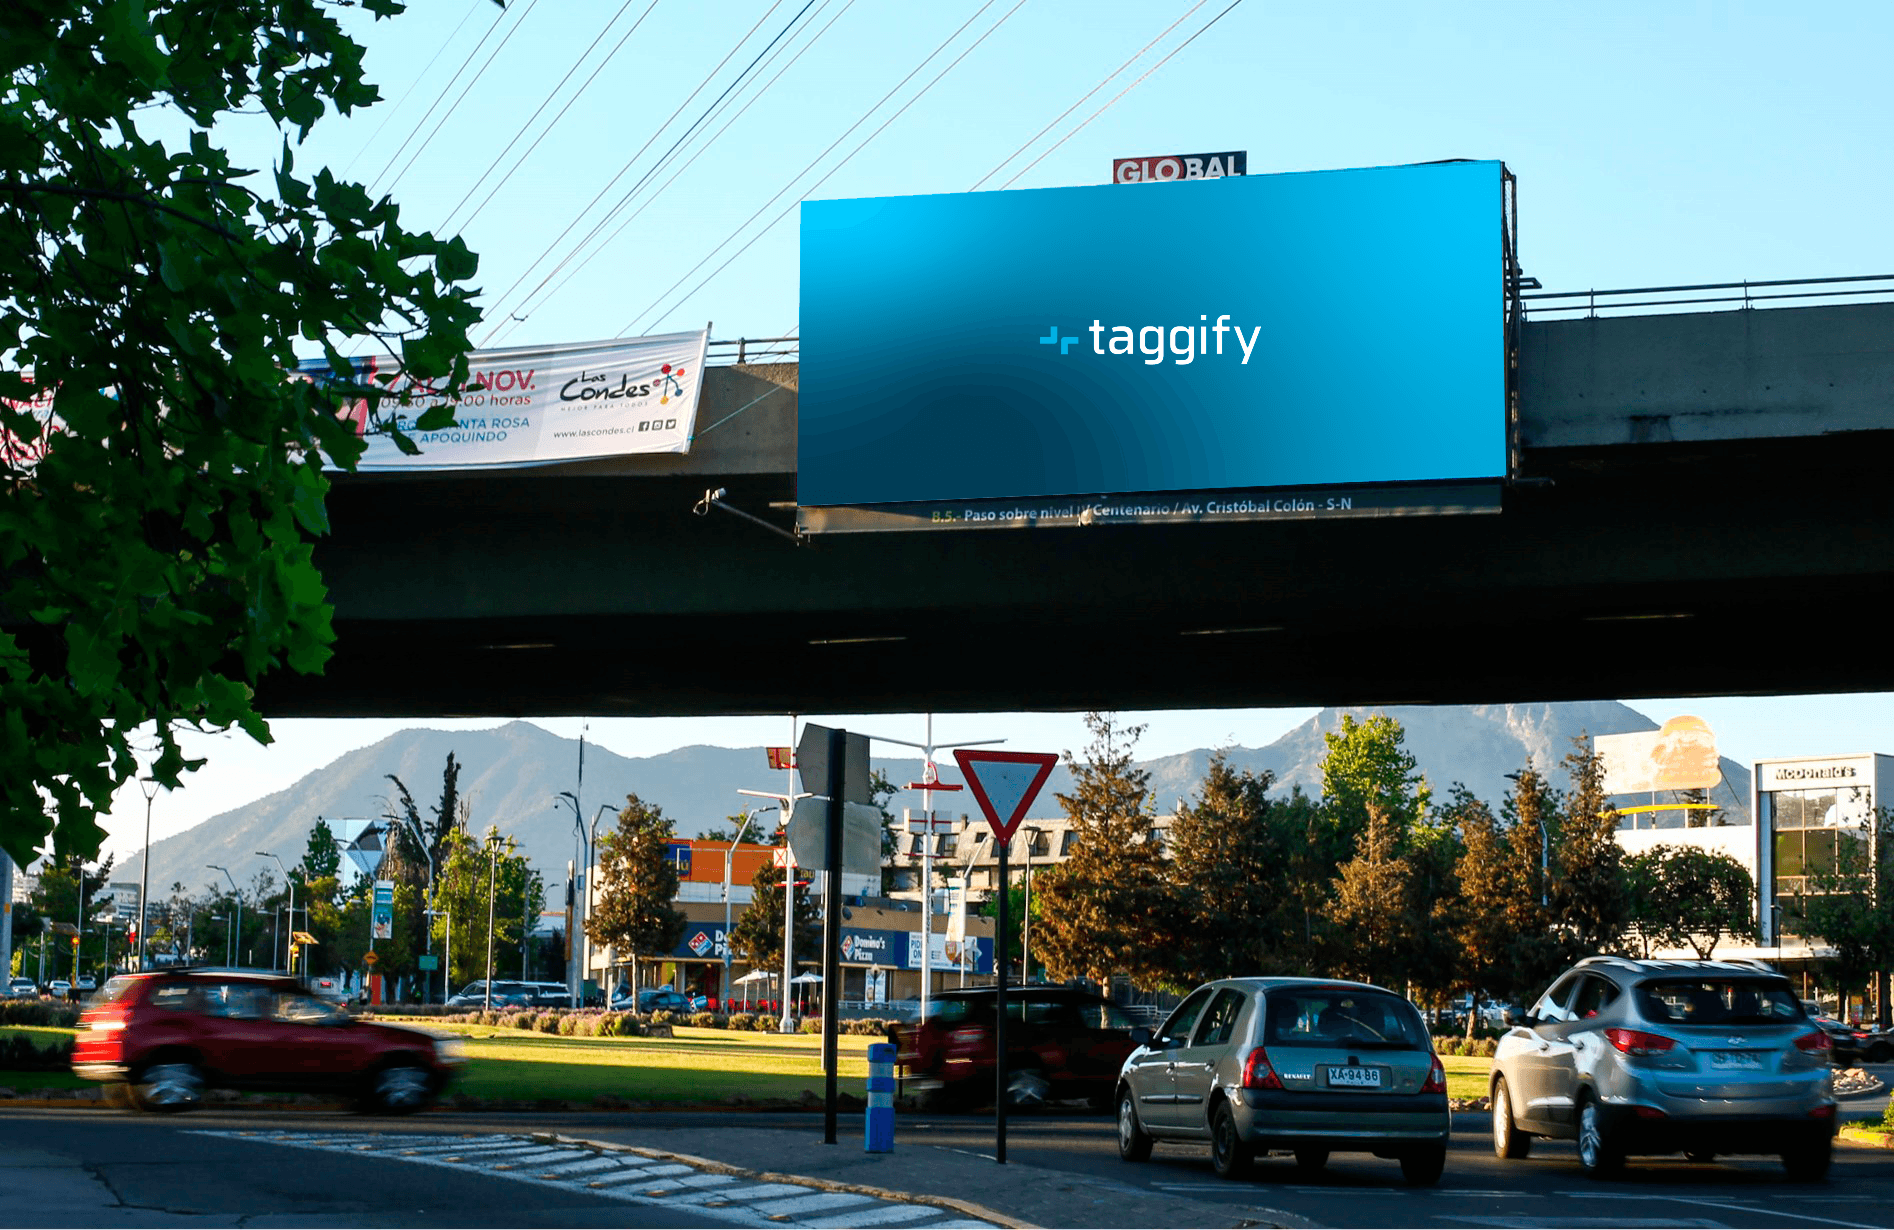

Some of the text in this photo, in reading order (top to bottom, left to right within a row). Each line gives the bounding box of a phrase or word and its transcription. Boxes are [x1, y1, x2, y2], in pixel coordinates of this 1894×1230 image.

[1117, 155, 1242, 183] GLOBAL
[1089, 314, 1262, 365] taggify
[476, 369, 536, 392] NOV.
[581, 371, 606, 382] Las
[560, 373, 651, 402] Condes
[489, 394, 532, 407] horas
[491, 417, 530, 429] ROSA
[420, 430, 508, 444] APOQUINDO
[553, 425, 635, 439] www.lascondes.cl
[964, 509, 996, 522] Paso
[999, 507, 1037, 521] sobre
[1040, 505, 1073, 519] nivel
[1093, 502, 1170, 516] Centenario
[1181, 502, 1203, 515] Av.
[1206, 500, 1270, 514] Cristóbal
[1273, 499, 1315, 513] Colón
[1326, 497, 1352, 511] S-N
[1776, 766, 1856, 780] McDonald's
[853, 935, 886, 950] Domino's
[853, 948, 873, 962] Pizza
